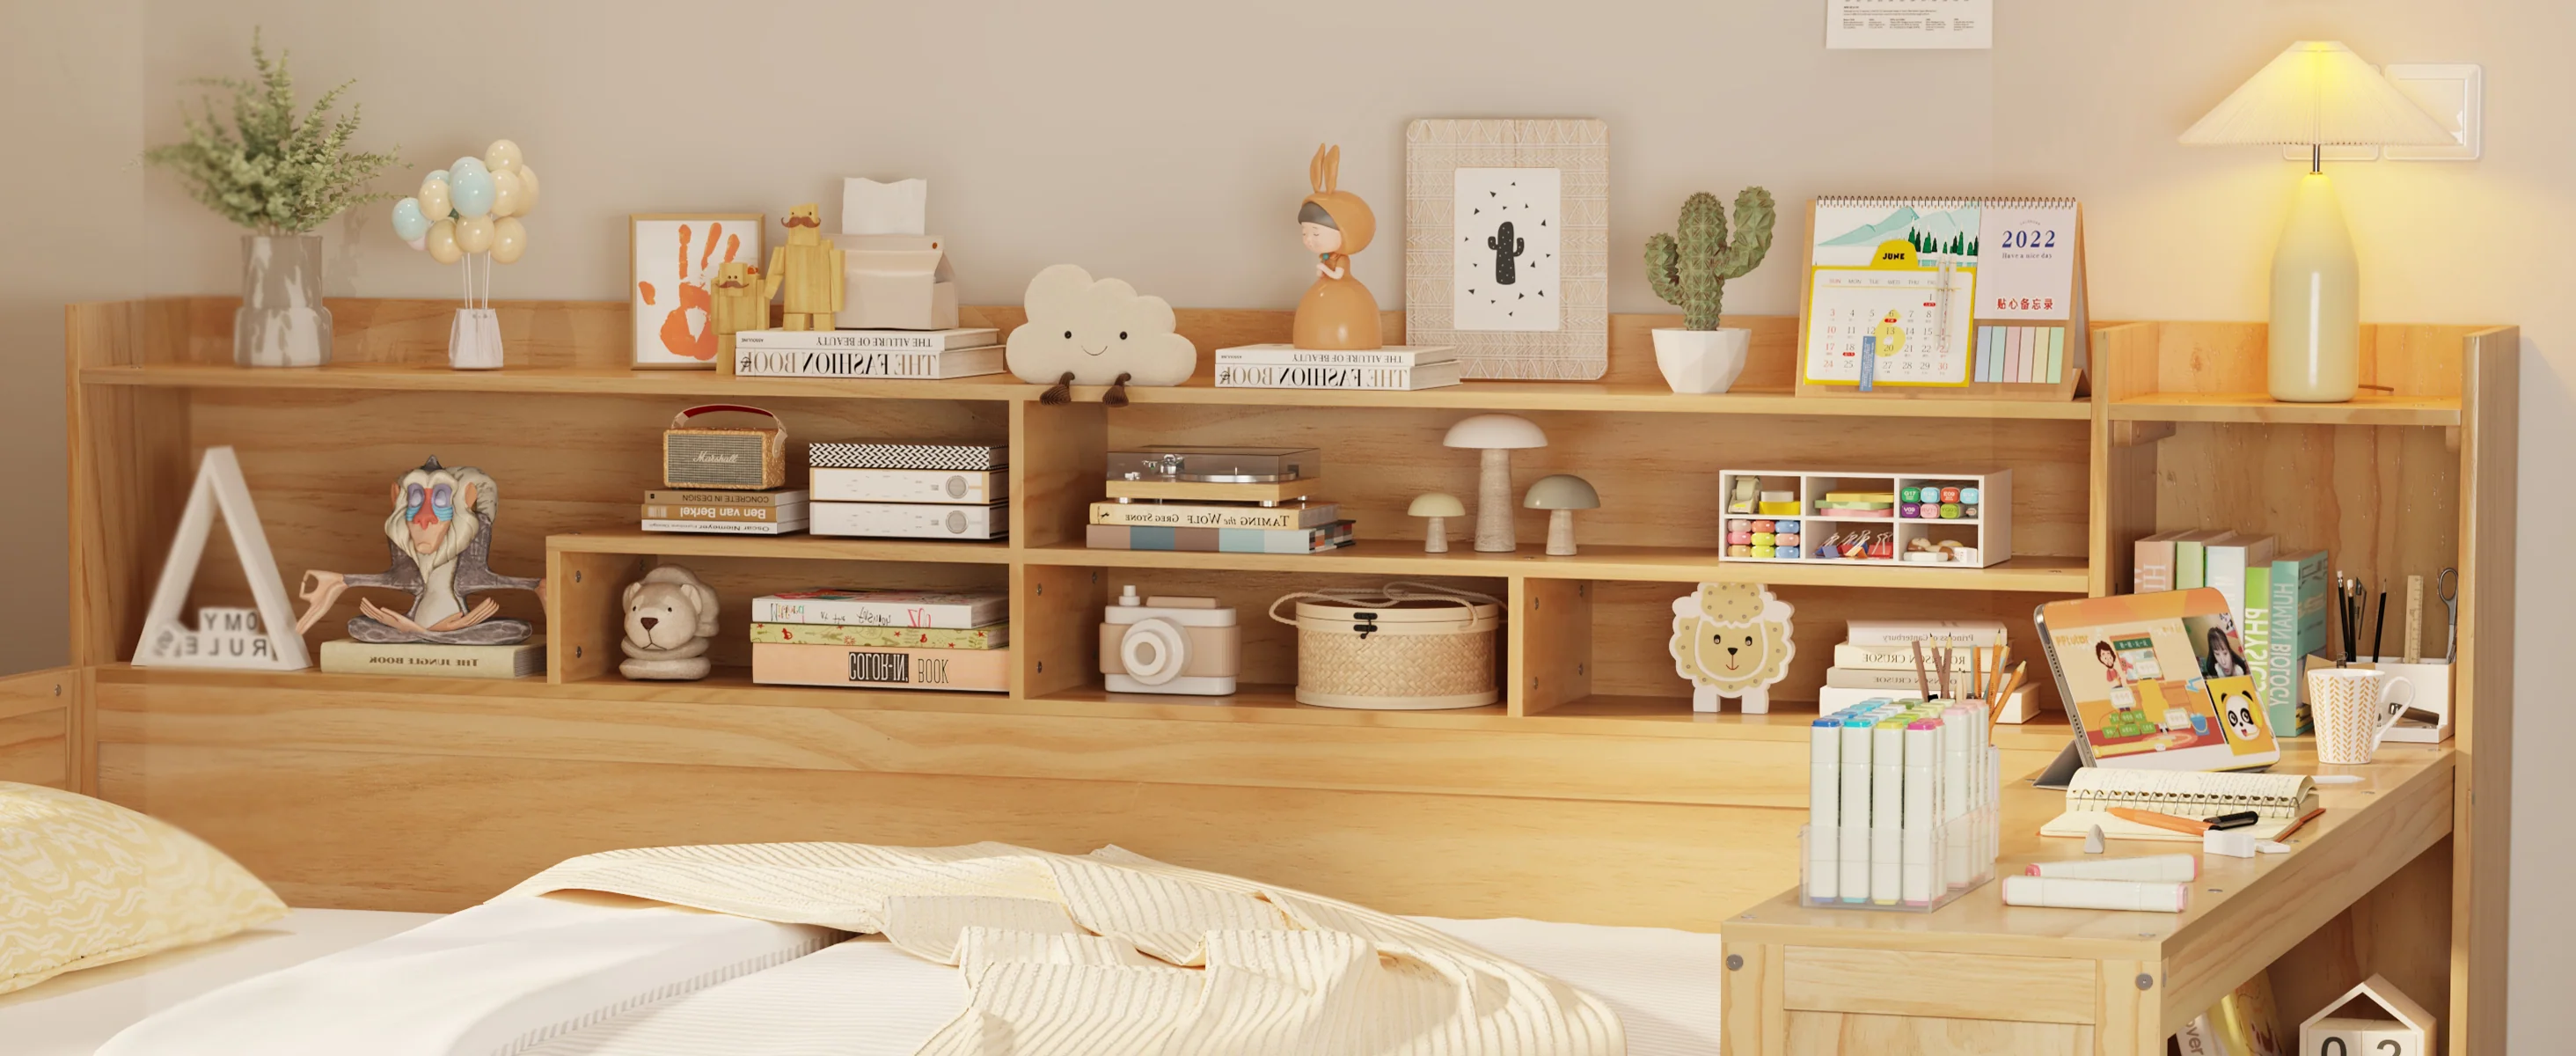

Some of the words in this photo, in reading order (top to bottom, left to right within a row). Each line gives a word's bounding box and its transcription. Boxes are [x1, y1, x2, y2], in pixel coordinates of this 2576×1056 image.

[2002, 230, 2055, 248] 2022
[1997, 297, 2053, 311] 贴心备忘录
[1830, 308, 1835, 317] 3
[1870, 309, 1875, 318] 5
[1889, 309, 1894, 318] 6
[1926, 310, 1932, 319] 8
[1827, 326, 1837, 334] 10
[1867, 326, 1876, 334] 12
[1886, 326, 1895, 335] 13
[1906, 326, 1914, 335] 14
[816, 336, 855, 346] BEAUTY
[858, 337, 870, 347] OF
[872, 337, 910, 348] ALLURE
[913, 338, 933, 348] THE
[1826, 342, 1835, 351] 17
[1292, 354, 1330, 363] BEAUTY
[1331, 354, 1343, 363] OF
[1345, 354, 1382, 363] ALLURE
[1385, 355, 1403, 363] THE
[1844, 360, 1854, 369] 25
[1938, 362, 1948, 370] 30
[693, 451, 739, 463] Marshall
[682, 494, 713, 502] DESIGN
[725, 495, 769, 503] CONCRETE
[680, 506, 716, 518] Berkel
[720, 508, 741, 517] van
[743, 509, 766, 519] Ben
